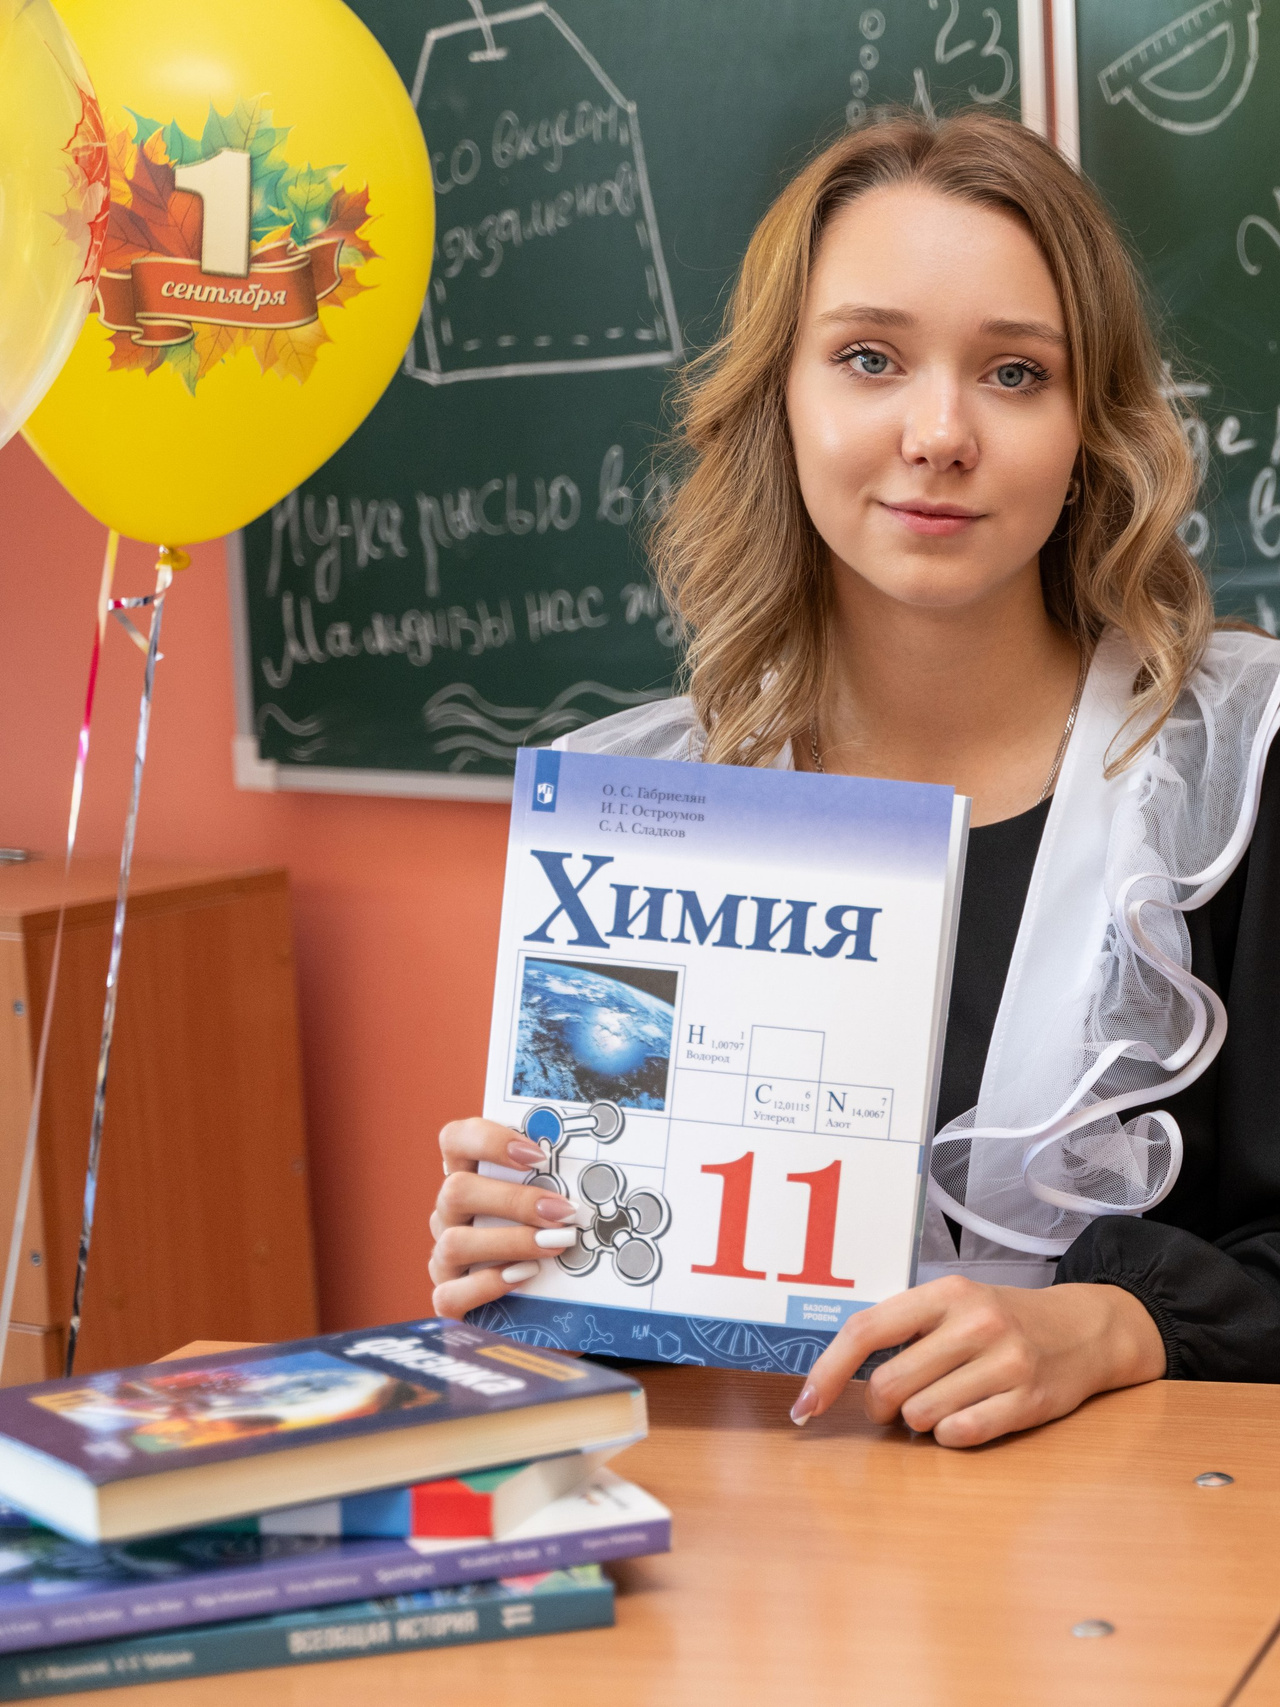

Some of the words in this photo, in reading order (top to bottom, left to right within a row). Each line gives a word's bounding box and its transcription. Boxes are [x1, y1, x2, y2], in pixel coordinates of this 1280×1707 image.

[174, 147, 252, 279] 1
[161, 280, 287, 312] сентября
[602, 784, 618, 798] О.
[621, 786, 635, 799] С.
[637, 787, 707, 805] Габриелян
[601, 802, 616, 815] И.
[619, 803, 630, 816] Г.
[632, 805, 705, 823] Остроумов
[598, 819, 612, 833] С.
[615, 822, 628, 834] А.
[631, 823, 687, 839] Сладков
[523, 849, 883, 962] Химия
[711, 1040, 744, 1051] 1,00797
[686, 1050, 730, 1064] Водород
[774, 1101, 810, 1112] 12,01115
[826, 1091, 847, 1113] N
[753, 1110, 795, 1124] Углерод
[852, 1108, 885, 1119] 14,0067
[826, 1119, 851, 1129] Азот
[691, 1151, 855, 1289] 11
[803, 1303, 842, 1314] БАЗОВЫЙ
[803, 1313, 839, 1323] УРОВЕНЬ
